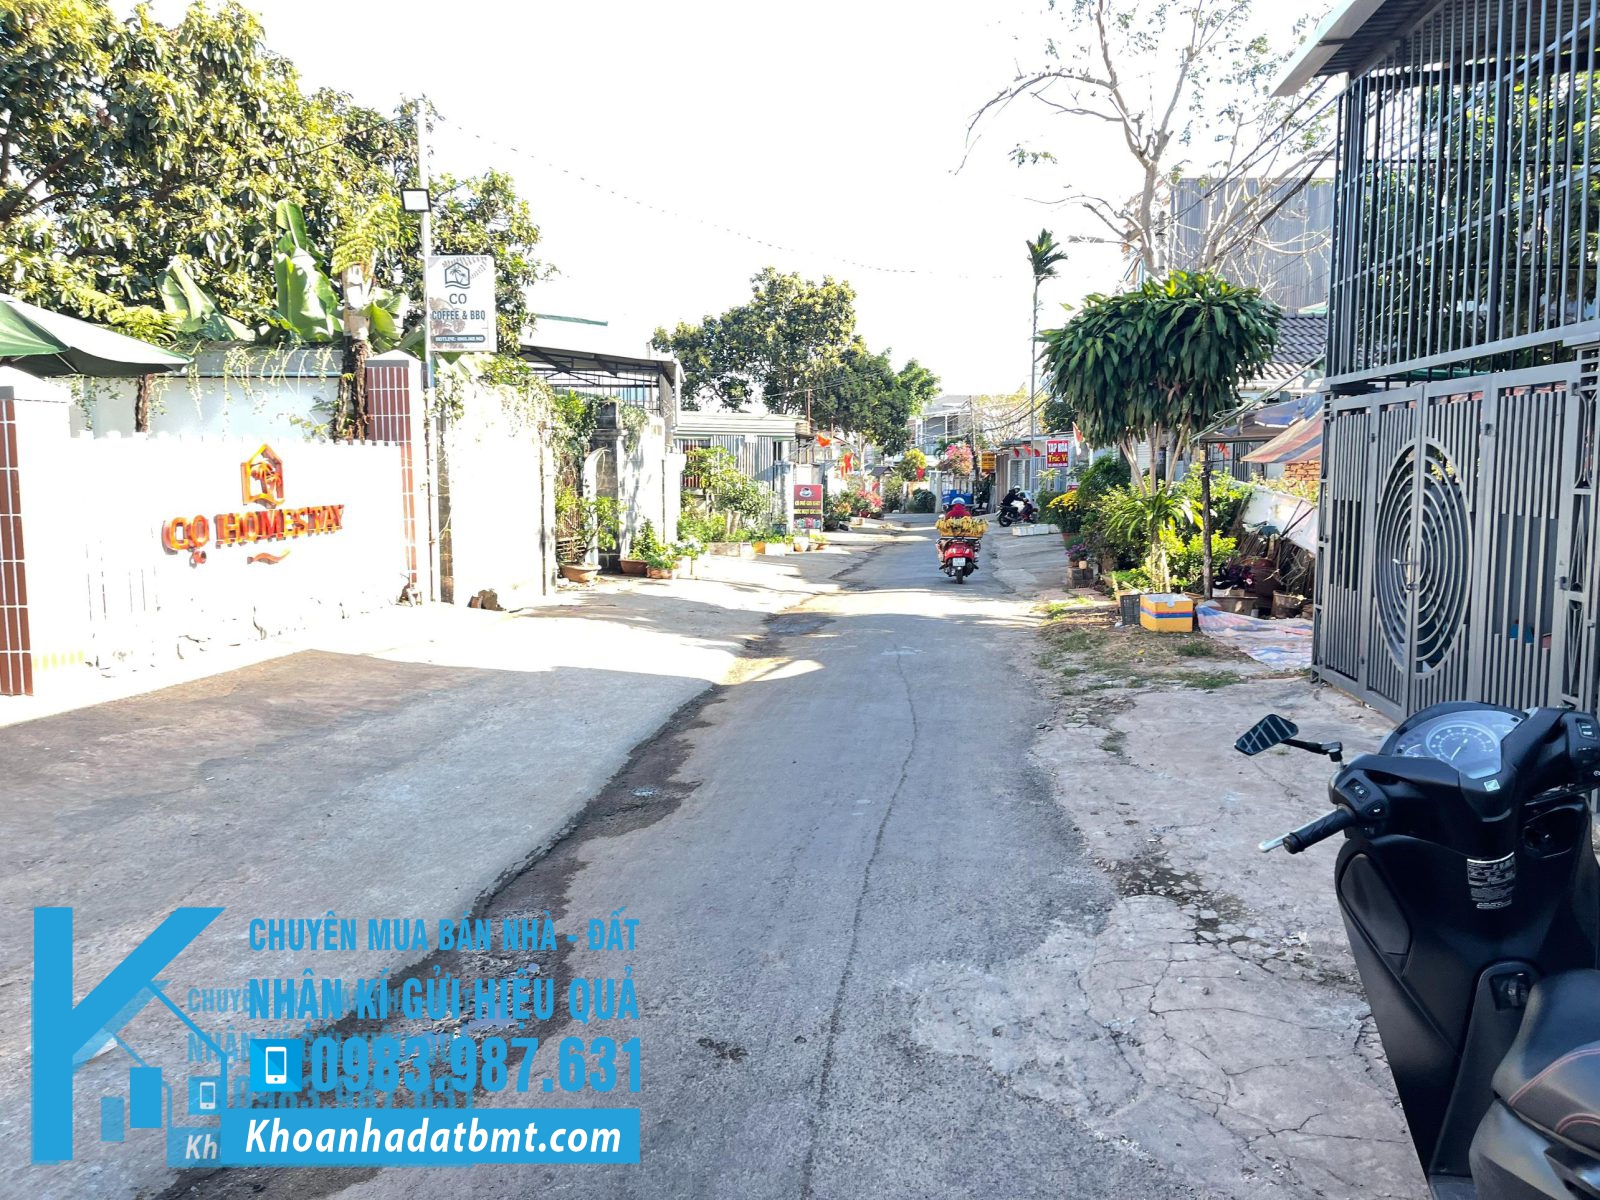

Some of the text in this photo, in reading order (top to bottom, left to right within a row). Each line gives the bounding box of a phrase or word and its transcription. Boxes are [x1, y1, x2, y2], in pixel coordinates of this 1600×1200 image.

[432, 310, 486, 321] COFFEE & BBQ
[214, 505, 344, 546] HOMESTAY
